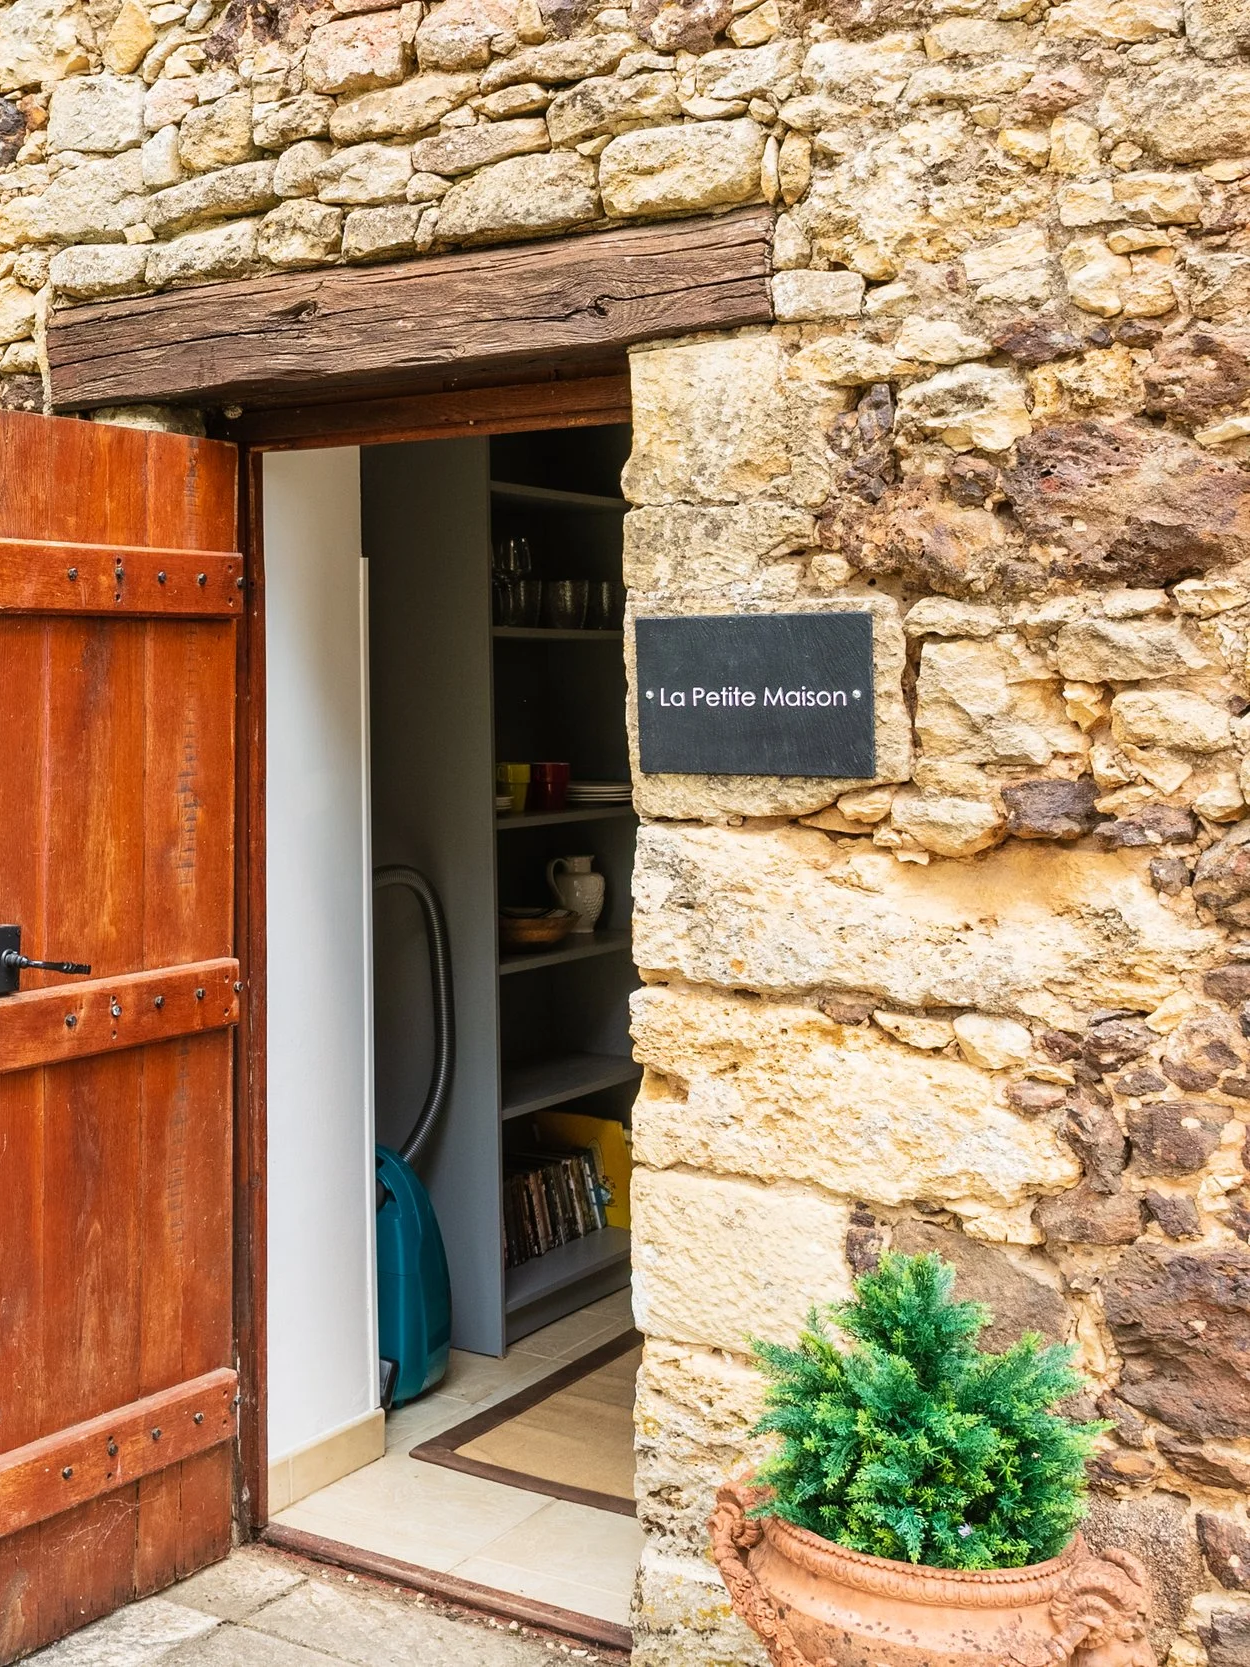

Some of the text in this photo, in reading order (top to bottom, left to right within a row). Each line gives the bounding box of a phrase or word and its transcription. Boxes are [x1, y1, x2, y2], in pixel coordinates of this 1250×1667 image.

[659, 685, 848, 707] La Petite Maison
